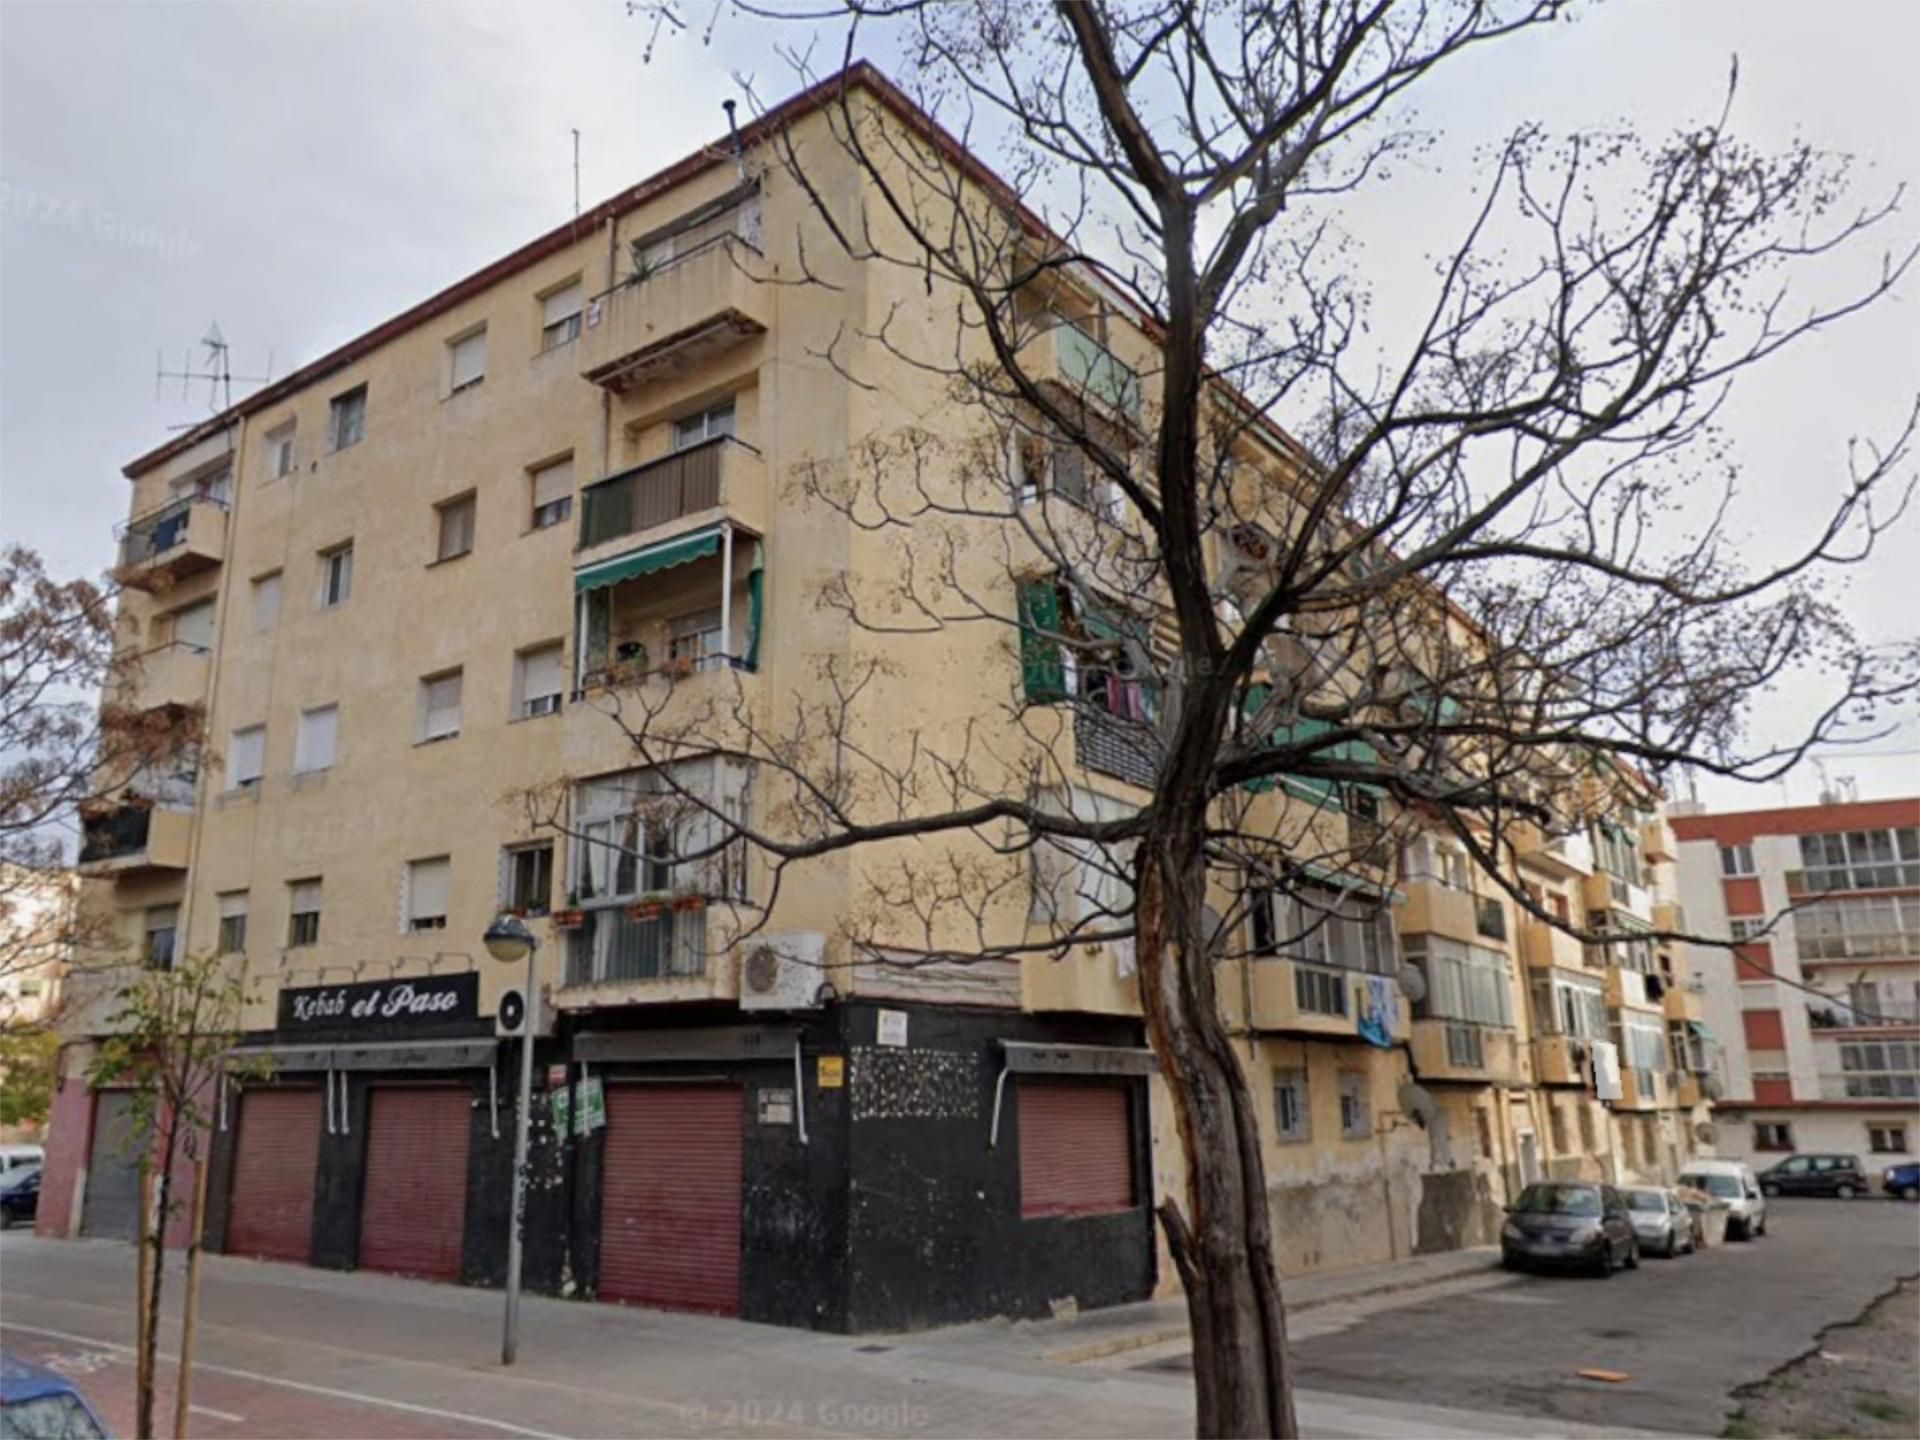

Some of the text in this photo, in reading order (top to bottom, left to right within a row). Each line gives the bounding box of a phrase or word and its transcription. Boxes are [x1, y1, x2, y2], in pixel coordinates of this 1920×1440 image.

[293, 983, 458, 1021] Kebab el Paso
